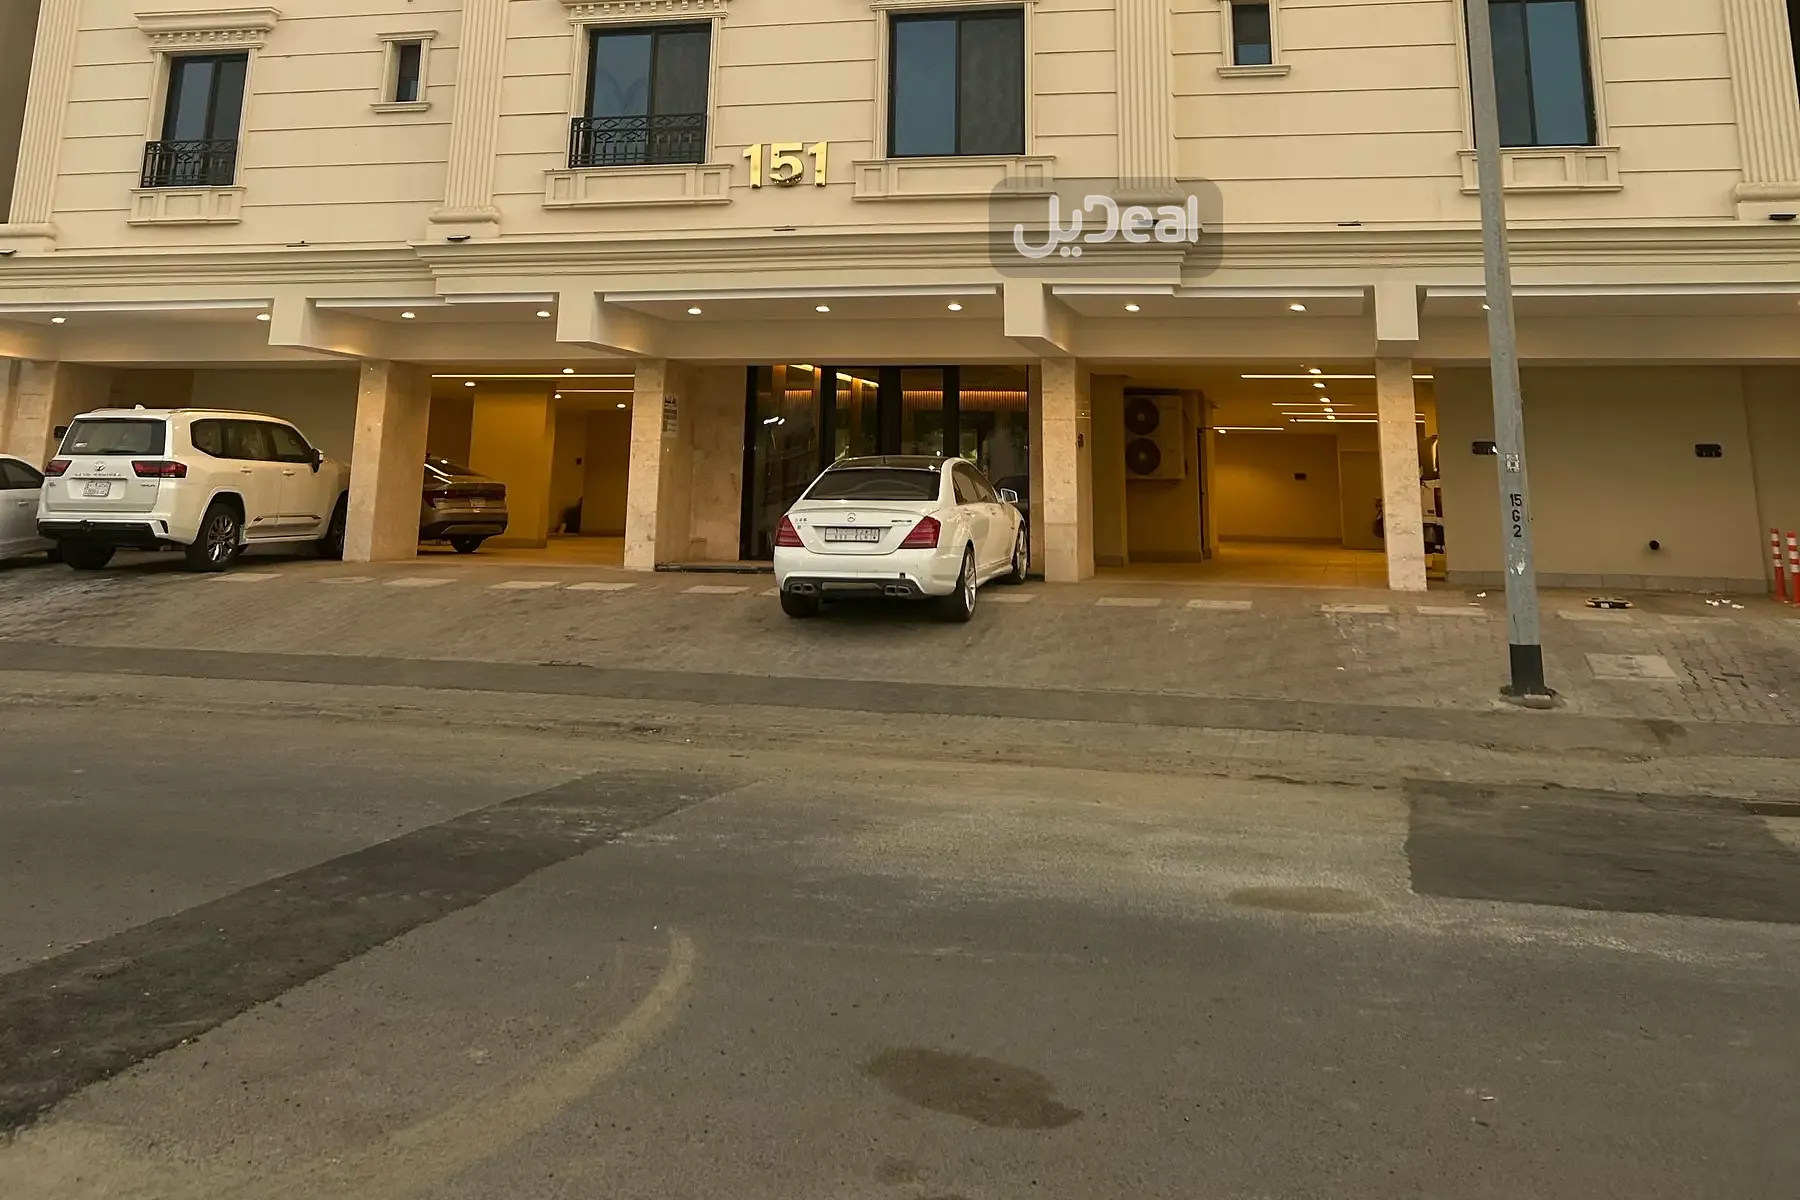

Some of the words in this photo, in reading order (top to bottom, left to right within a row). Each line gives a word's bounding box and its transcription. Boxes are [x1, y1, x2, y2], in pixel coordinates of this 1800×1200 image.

[743, 142, 828, 189] 151
[1510, 494, 1522, 507] 15
[1512, 509, 1521, 523] G
[1513, 524, 1522, 538] 2
